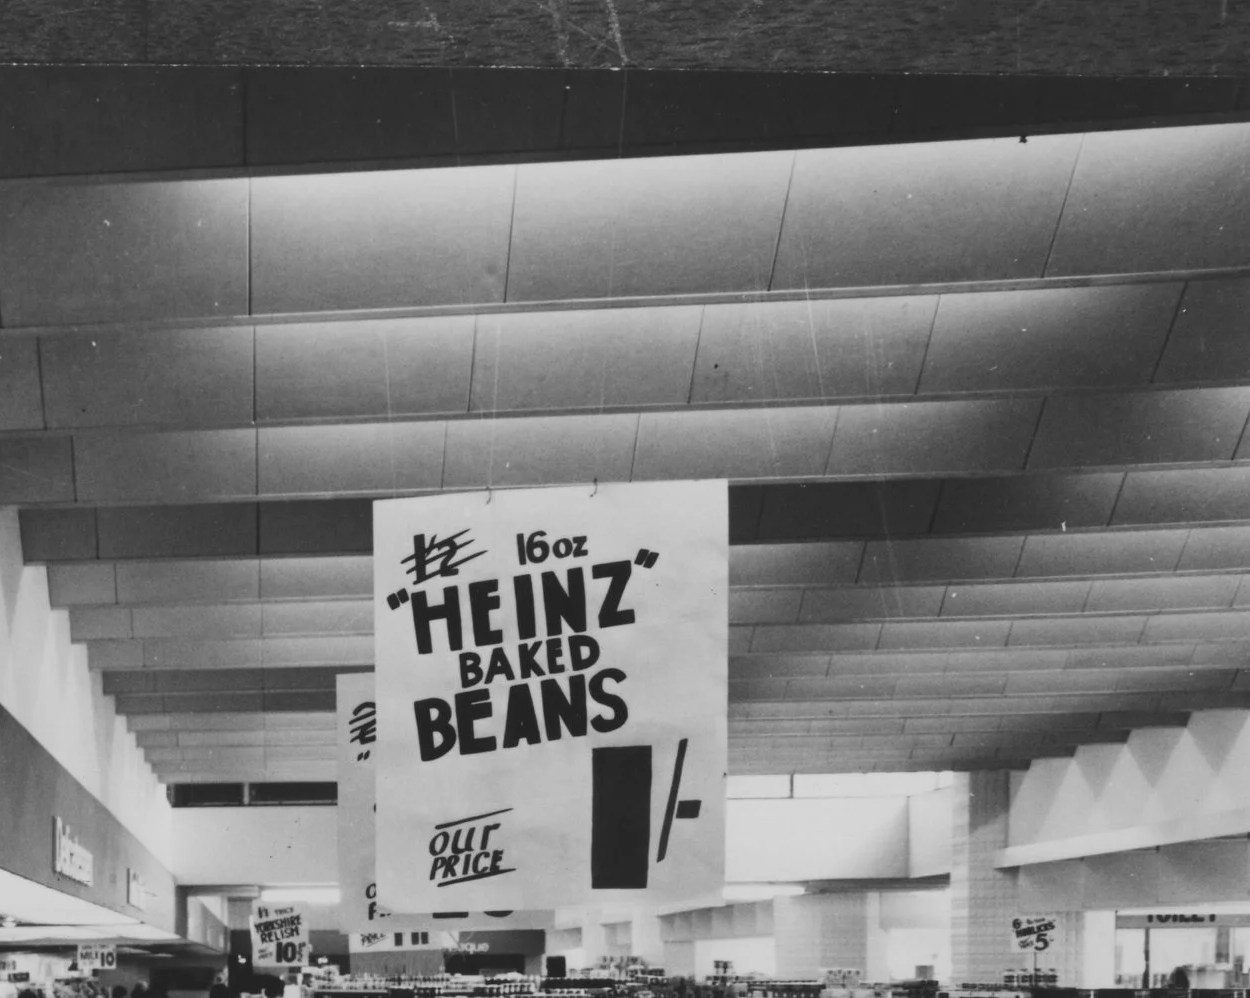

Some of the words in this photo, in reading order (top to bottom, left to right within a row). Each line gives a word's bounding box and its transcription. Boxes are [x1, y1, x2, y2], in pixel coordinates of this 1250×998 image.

[459, 634, 600, 689] BAKED
[414, 667, 629, 762] BEANS
[430, 849, 505, 881] PRICE
[254, 914, 302, 933] YORKSHIRE
[261, 927, 299, 943] RELISH
